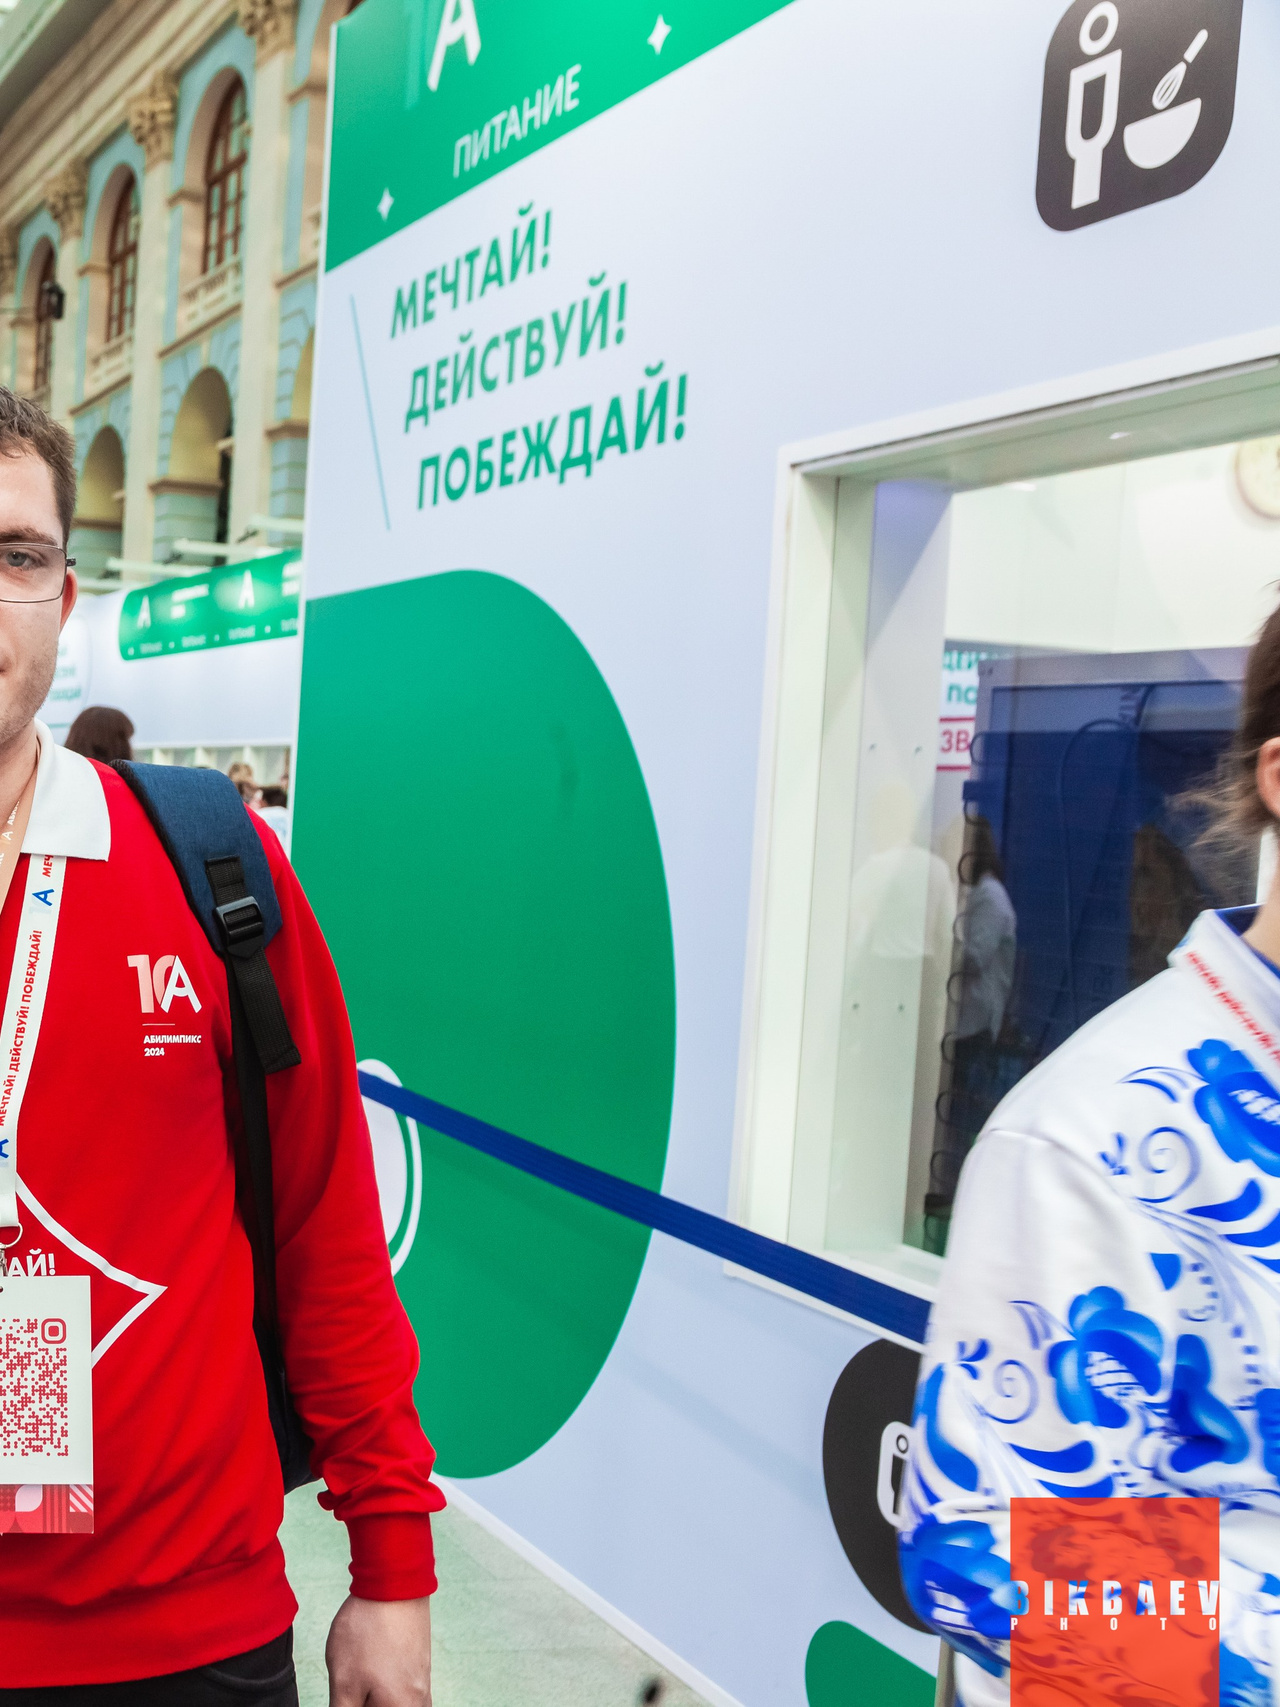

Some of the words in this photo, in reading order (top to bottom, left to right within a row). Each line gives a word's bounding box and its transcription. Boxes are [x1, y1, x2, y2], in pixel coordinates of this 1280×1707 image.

[453, 63, 582, 179] ПИТАНИЕ
[391, 200, 551, 339] МЕЧТАЙ!
[405, 270, 628, 433] ДЕЙСТВУЙ!
[418, 360, 688, 510] ПОБЕЖДАЙ!
[9, 1005, 30, 1073] ДЕЙСТВУЙ!
[21, 929, 42, 1003] ПОБЕЖДАЙ!
[143, 1034, 202, 1044] АБИЛИМПИКС
[144, 1047, 165, 1057] 2024
